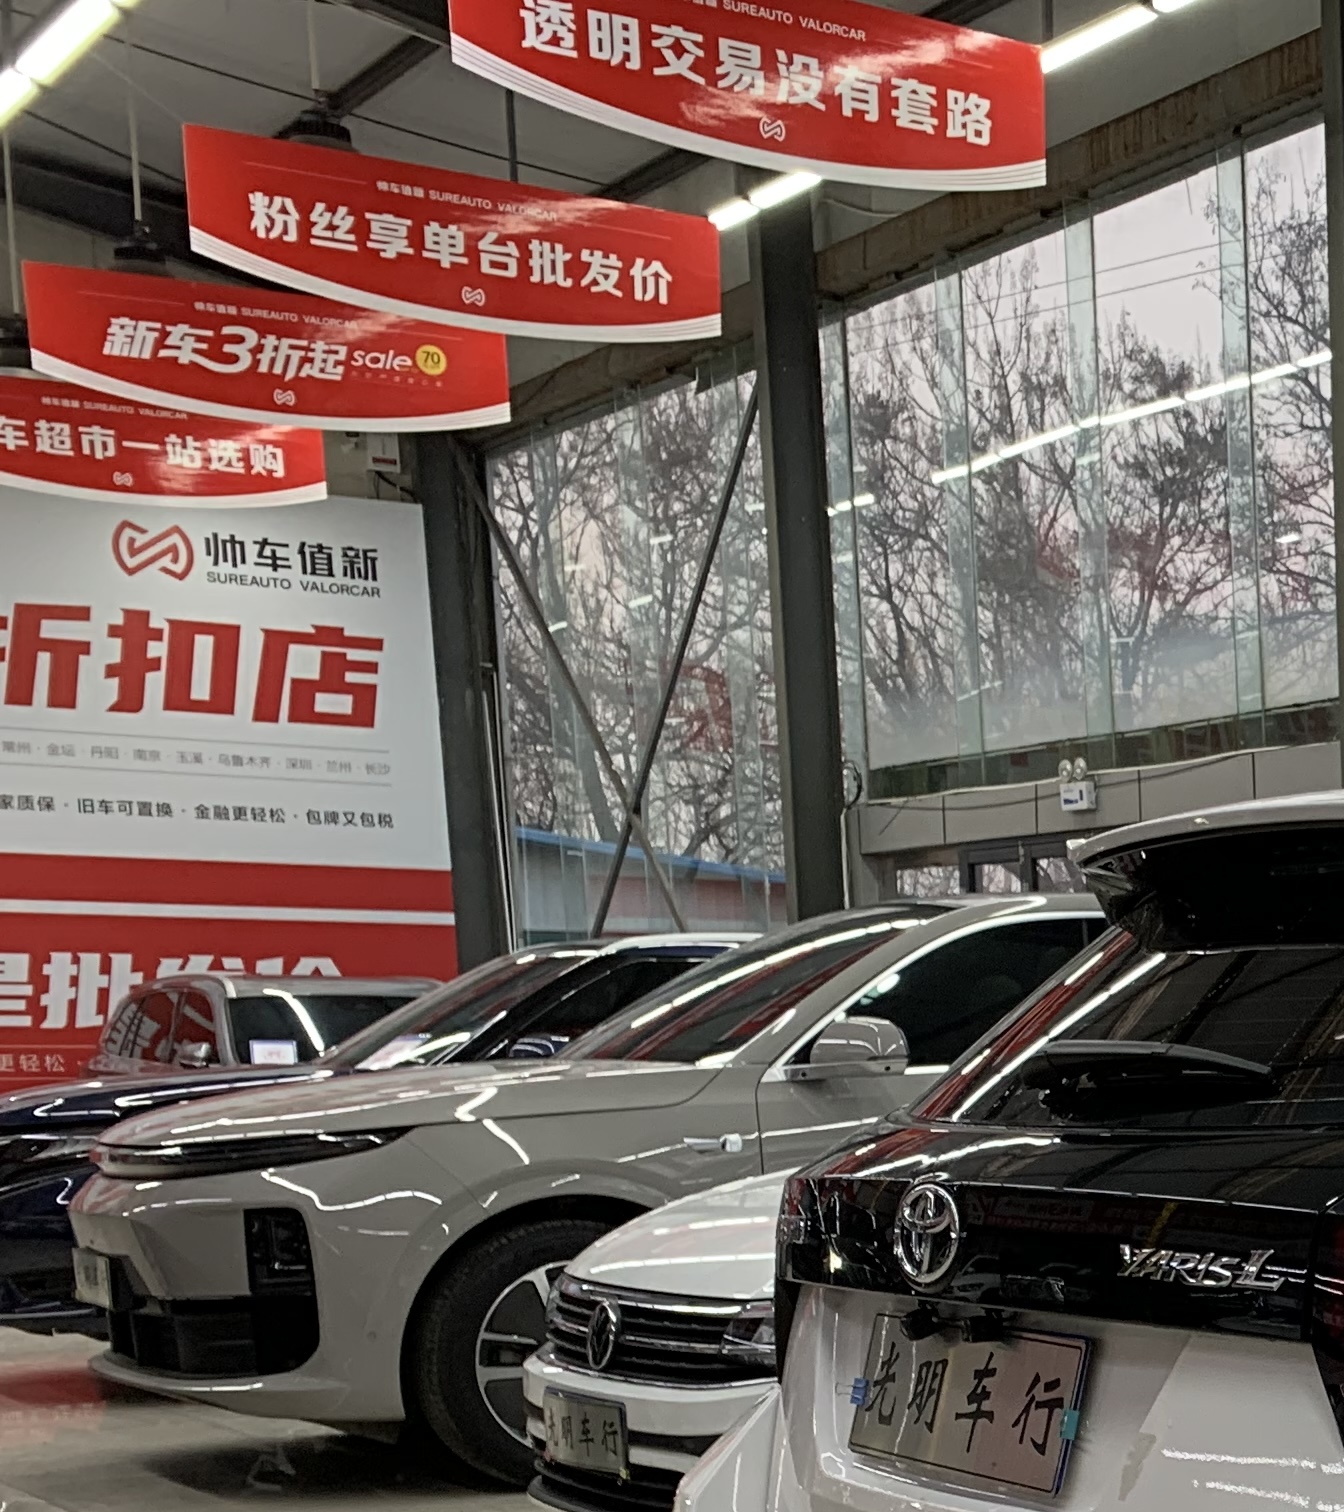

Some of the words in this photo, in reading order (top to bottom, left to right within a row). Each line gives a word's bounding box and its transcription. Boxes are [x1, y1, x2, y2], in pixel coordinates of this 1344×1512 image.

[723, 0, 792, 24] SUREAUTO
[799, 16, 866, 41] VALORCAR
[519, 0, 992, 146] 透明交易没有套路
[429, 190, 492, 209] SUREAUTO
[248, 191, 673, 306] 粉丝享单台批发价
[102, 316, 347, 382] 新车3折起
[350, 349, 413, 371] sale
[421, 351, 441, 365] 70
[0, 415, 286, 479] 车超市一站选购
[204, 532, 378, 582] 帅车值新
[207, 571, 292, 590] SUREAUTO
[300, 579, 381, 598] VALORCAR
[0, 603, 384, 728] 折扣店
[865, 1341, 1064, 1456] 光明车行
